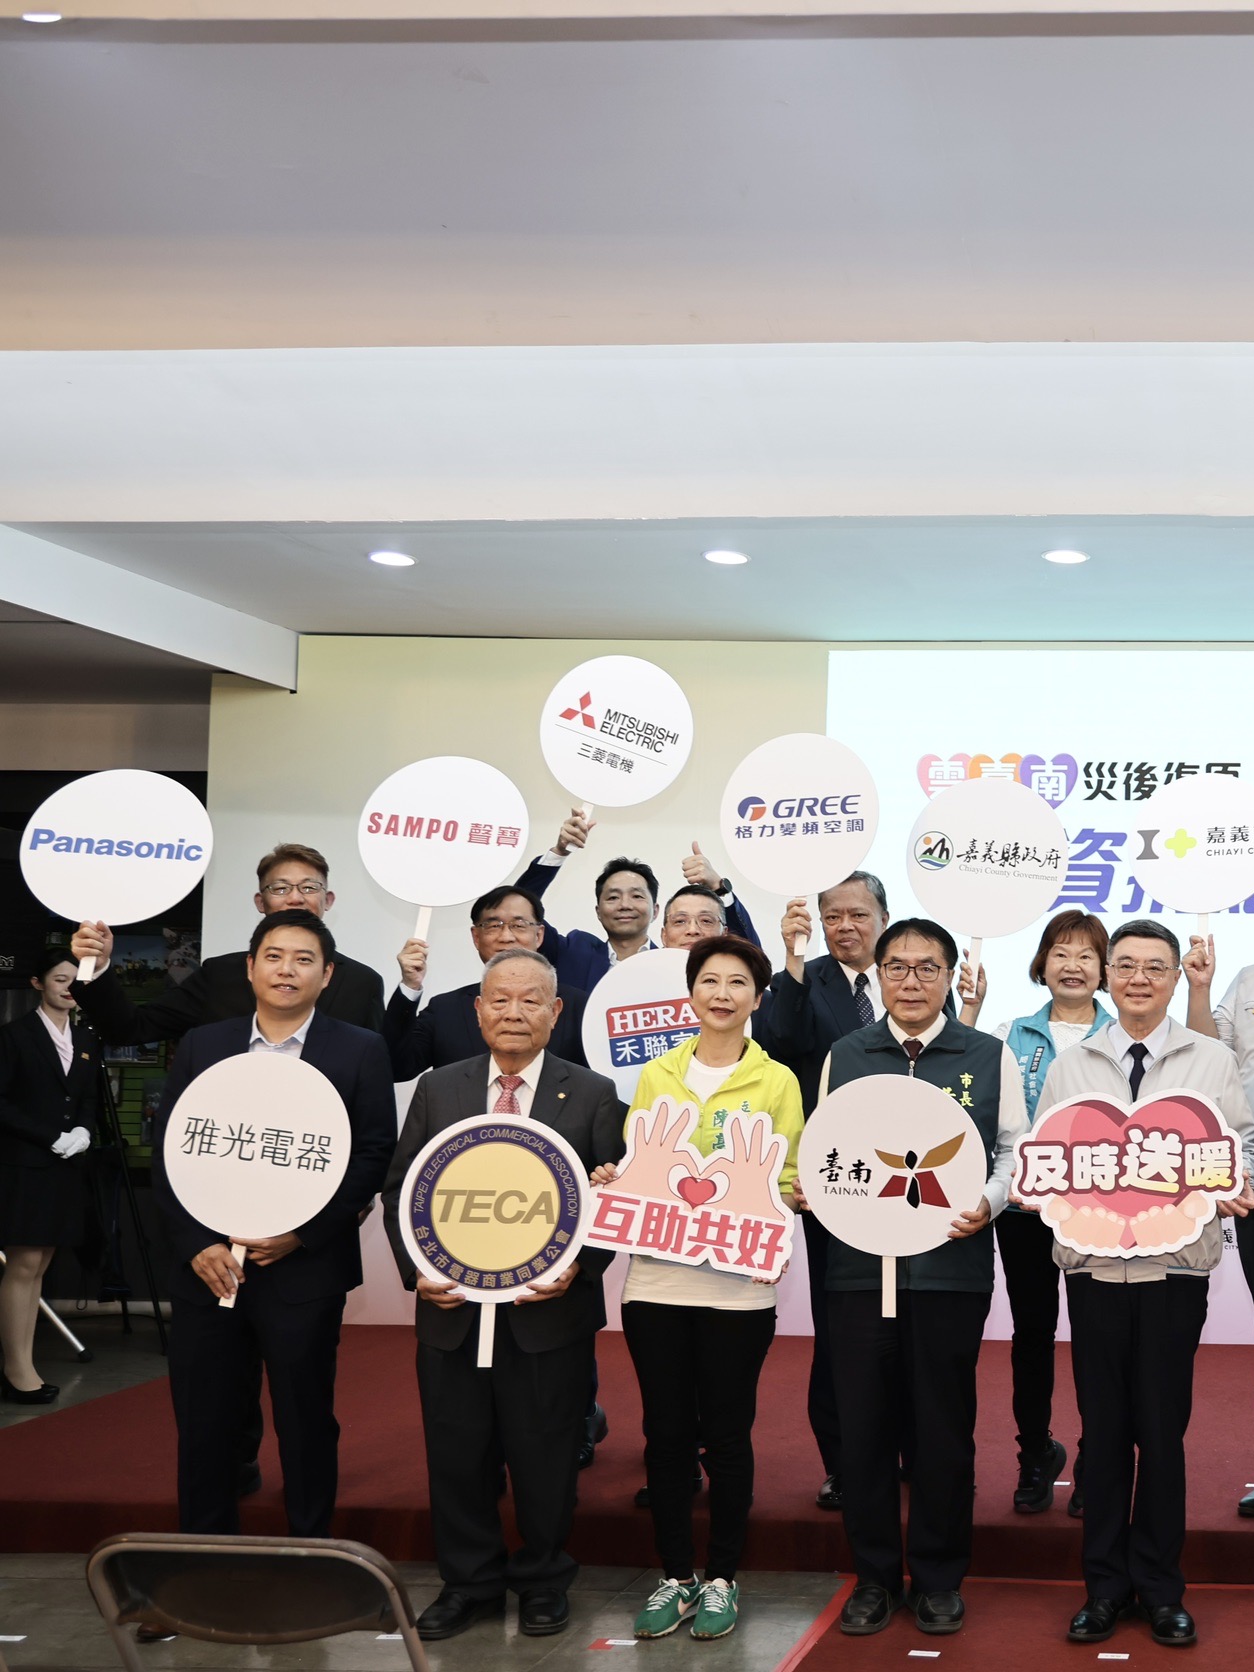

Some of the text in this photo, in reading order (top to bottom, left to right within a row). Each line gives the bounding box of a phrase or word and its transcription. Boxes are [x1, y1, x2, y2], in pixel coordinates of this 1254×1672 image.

[600, 721, 665, 753] ELECTRIC
[604, 709, 679, 745] MITSUBISHI
[577, 742, 634, 774] 三菱電機
[772, 794, 861, 819] GREE
[29, 828, 203, 861] Panasonic
[367, 812, 521, 848] SAMPO 聲寶
[735, 819, 864, 839] 格力變頻空調
[956, 838, 1061, 869] 嘉義縣政府
[1206, 848, 1244, 857] CHIAYI
[959, 864, 1058, 882] Chiayi County Government
[959, 1072, 975, 1107] 市長
[180, 1116, 332, 1173] 雅光電器
[1021, 1128, 1233, 1194] 及時送暖
[414, 1128, 578, 1218] TAIPEI ELECTRICAL COMMERCIAL ASSOCIATION
[819, 1148, 872, 1184] 臺南
[436, 1189, 556, 1224] TECA
[822, 1185, 869, 1197] TAINAN
[588, 1192, 786, 1271] 互助共好
